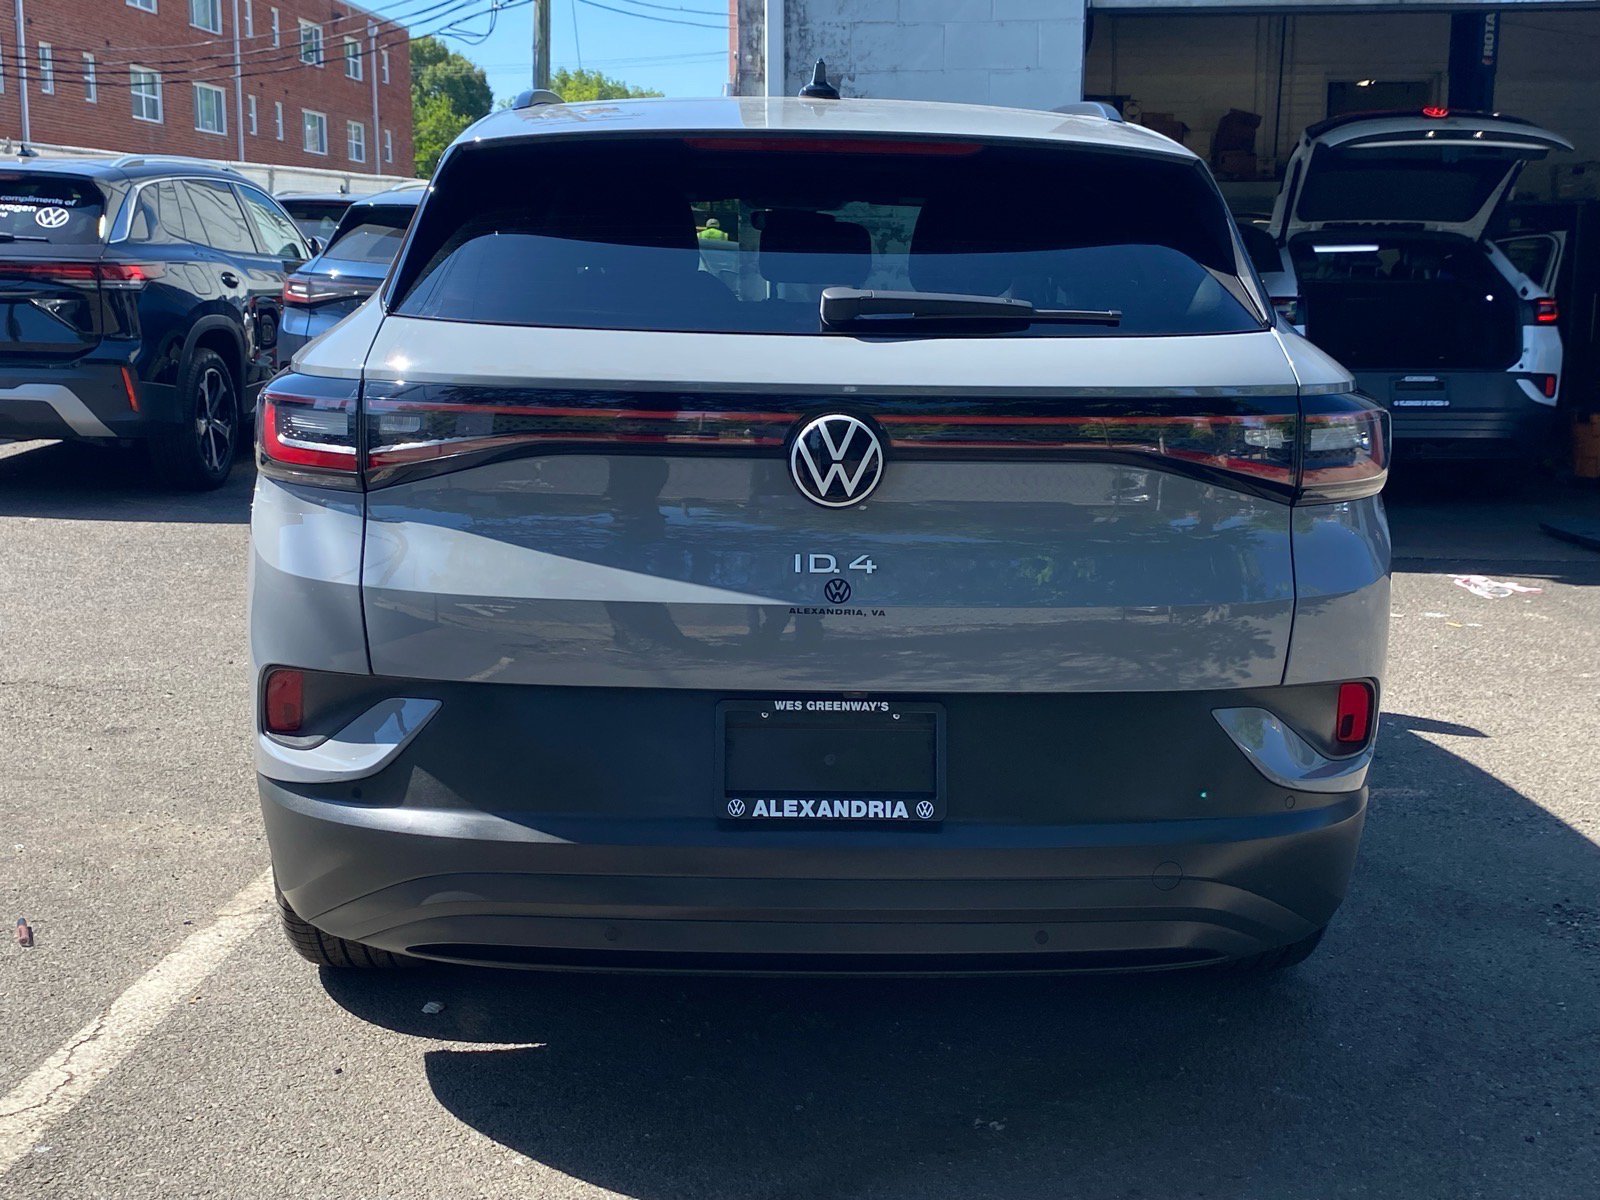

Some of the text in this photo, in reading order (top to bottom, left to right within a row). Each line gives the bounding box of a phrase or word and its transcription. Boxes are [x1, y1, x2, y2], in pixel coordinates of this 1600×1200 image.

[0, 195, 63, 205] compliments
[792, 415, 882, 506] VW
[788, 607, 886, 617] ALEXANDRIA, VA
[774, 700, 890, 712] WES GREENWAY'S
[751, 799, 909, 818] ALEXANDRIA
